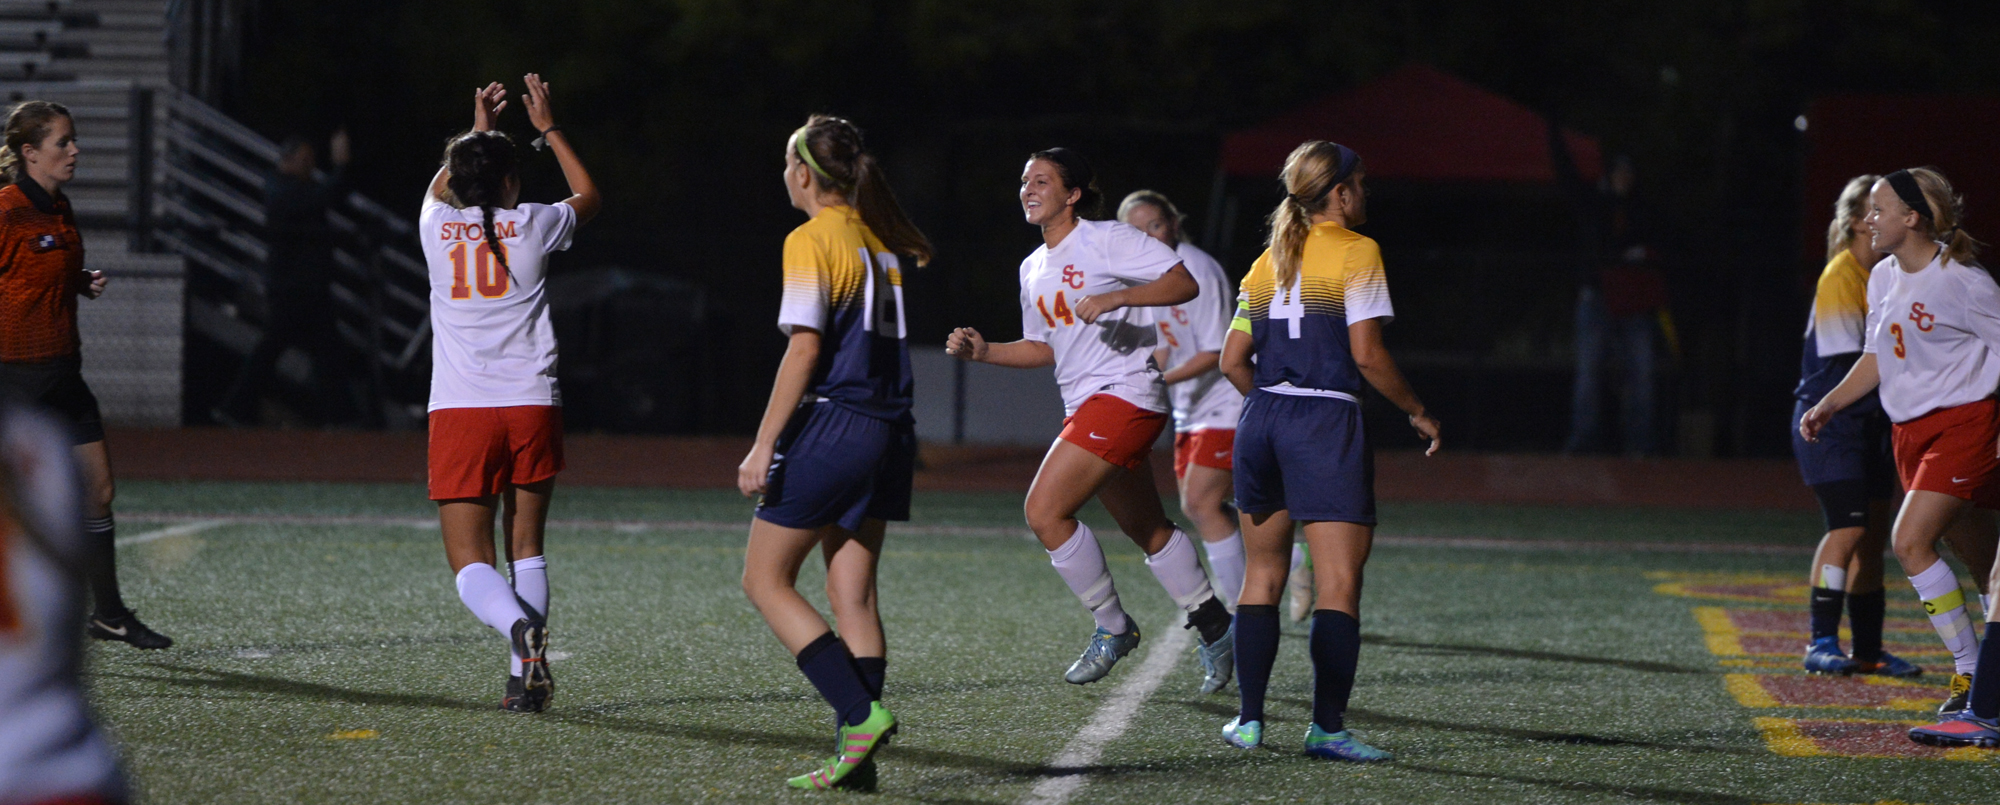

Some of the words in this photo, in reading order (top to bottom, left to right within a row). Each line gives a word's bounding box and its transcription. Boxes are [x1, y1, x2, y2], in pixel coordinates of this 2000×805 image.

[441, 221, 517, 241] STOM
[449, 241, 510, 300] 10
[1062, 264, 1084, 290] SC
[1036, 290, 1075, 328] 14
[1268, 270, 1305, 339] 4
[1908, 301, 1935, 333] SC
[1889, 322, 1906, 360] 3
[1923, 601, 1936, 615] C
